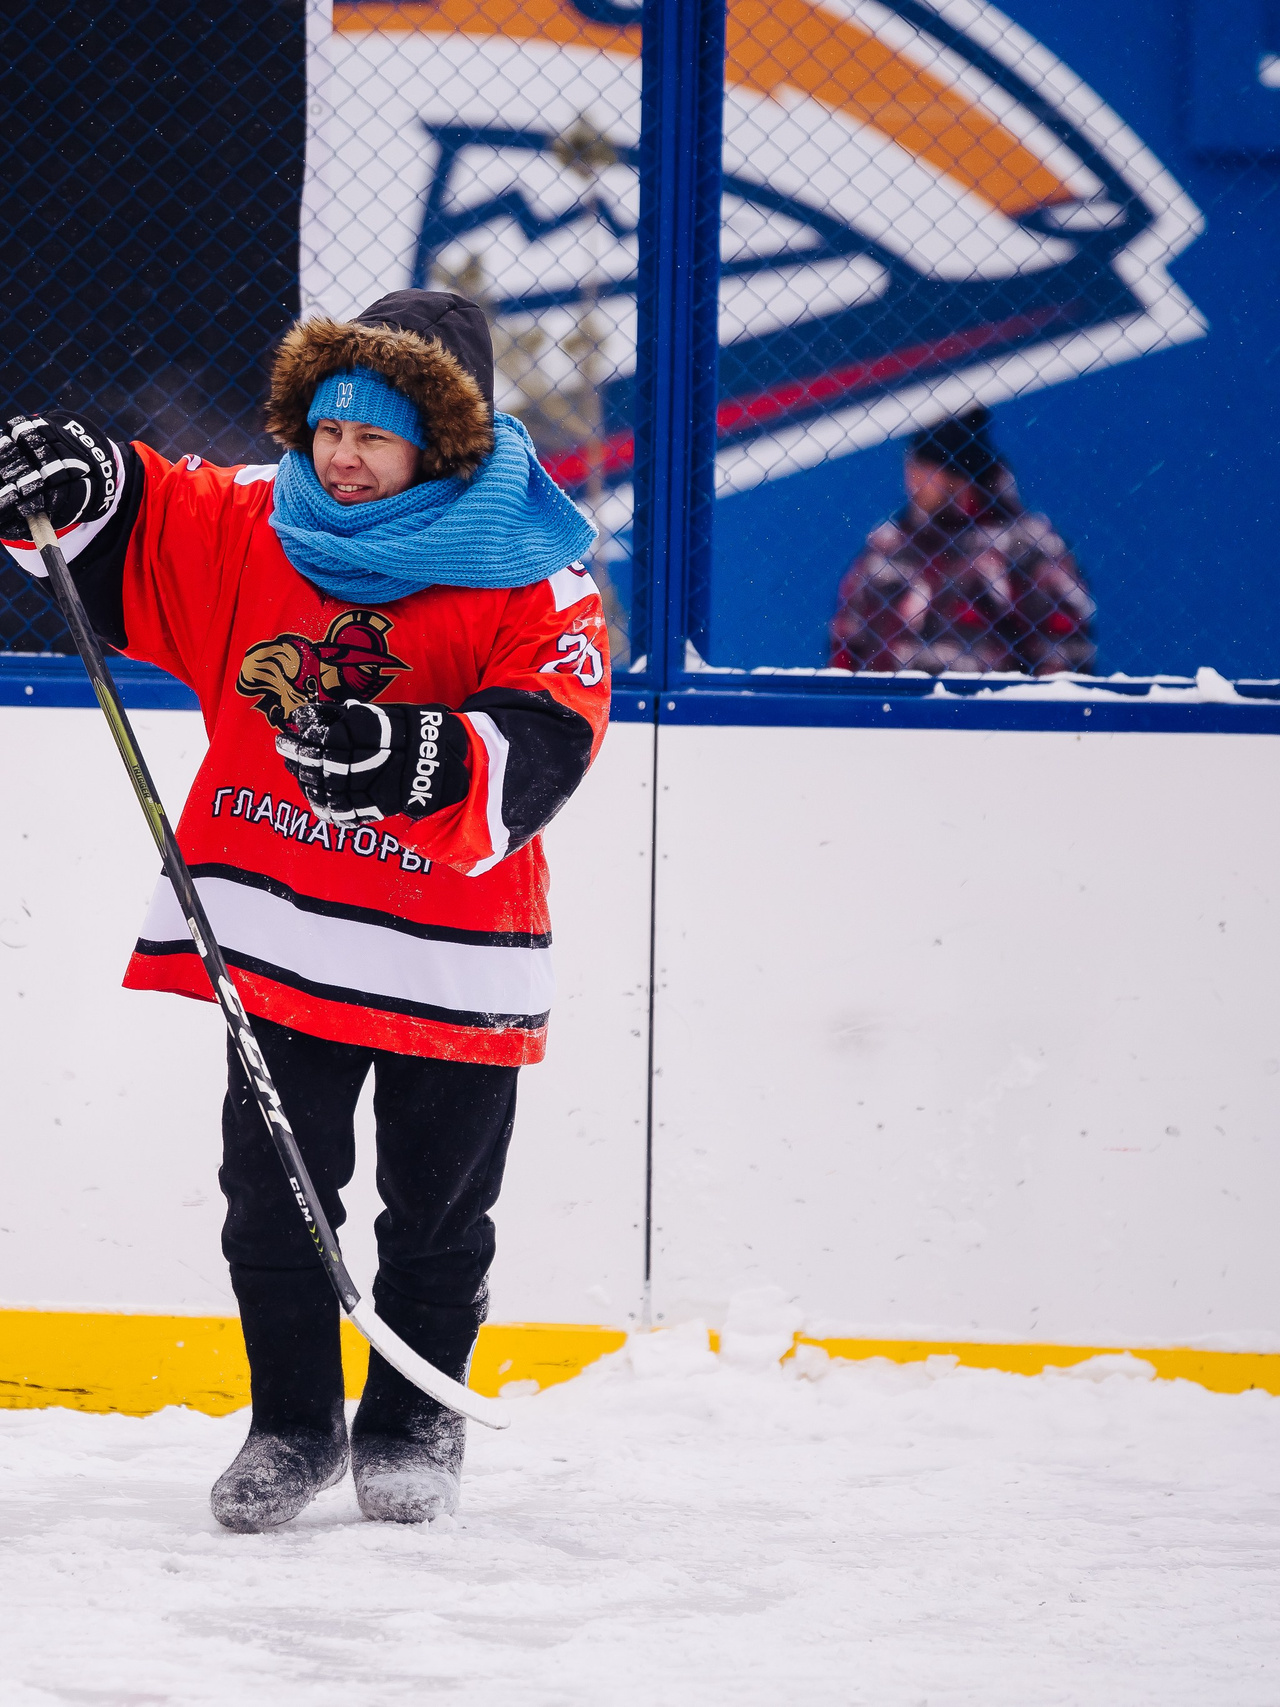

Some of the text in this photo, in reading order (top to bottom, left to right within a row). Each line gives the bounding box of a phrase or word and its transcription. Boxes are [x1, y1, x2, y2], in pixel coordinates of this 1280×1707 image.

[63, 420, 115, 512] Reebok
[132, 763, 151, 799] TRIGGER
[407, 711, 443, 807] Reebok
[212, 786, 434, 875] ГЛАДИАТОРЫ
[218, 974, 293, 1136] CCM
[289, 1177, 313, 1222] CCM
